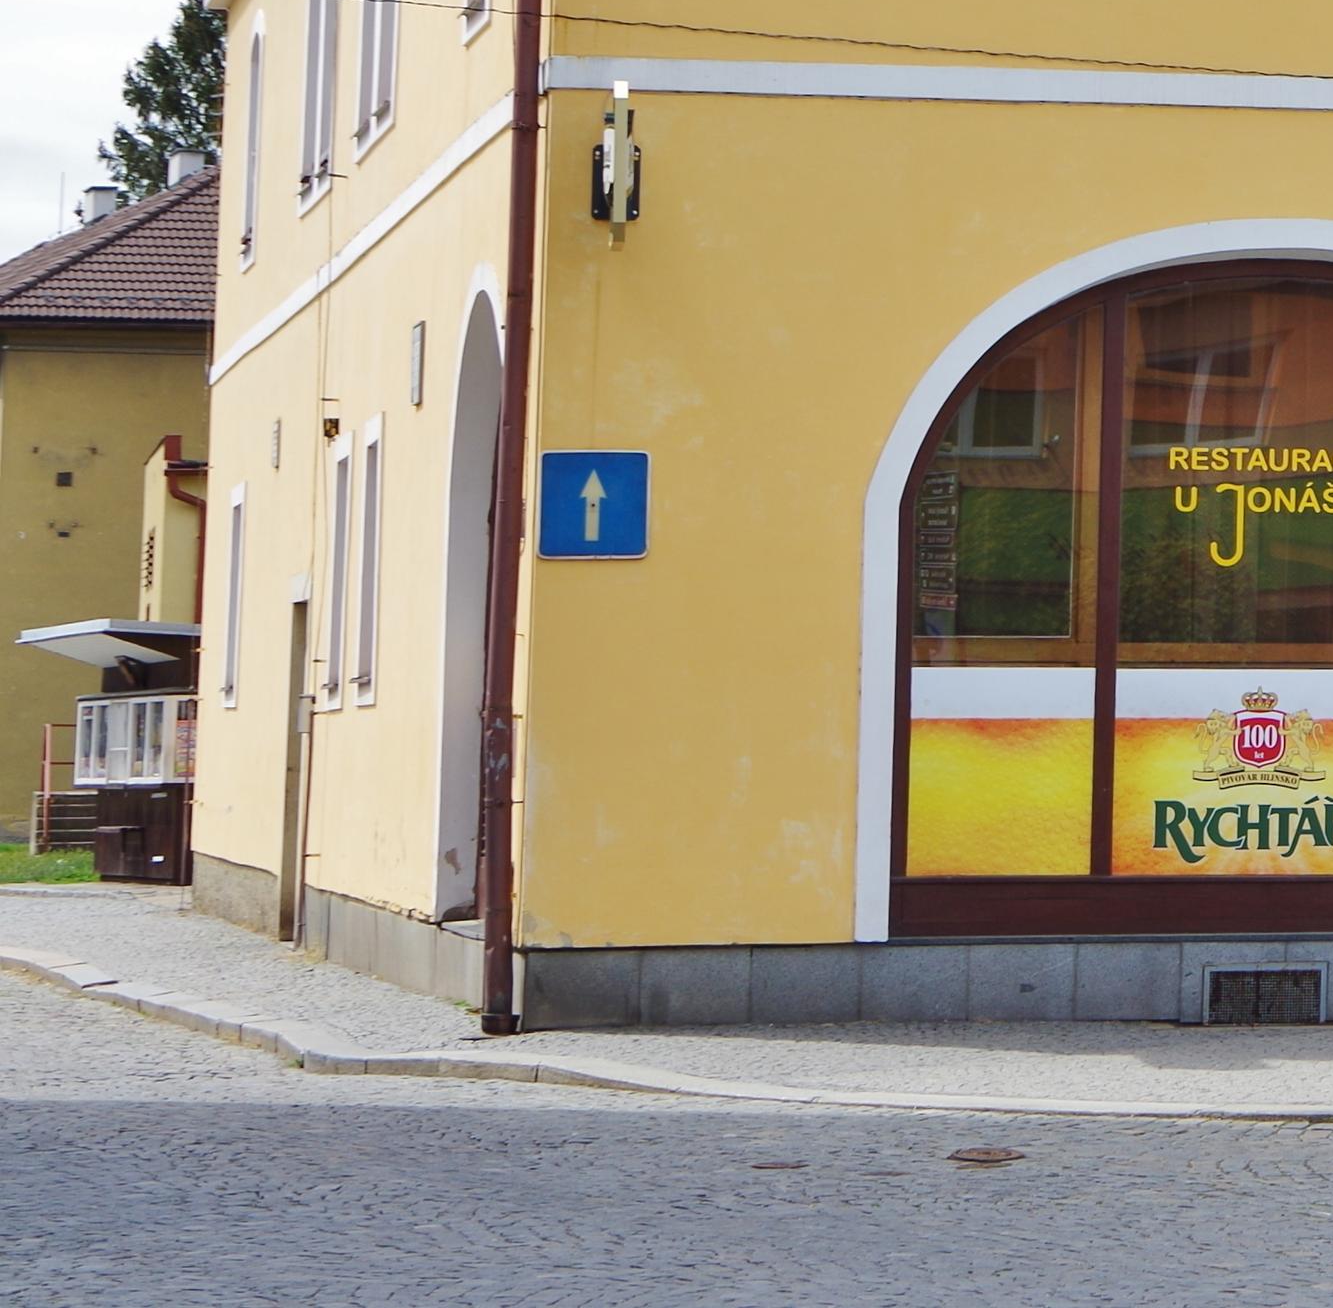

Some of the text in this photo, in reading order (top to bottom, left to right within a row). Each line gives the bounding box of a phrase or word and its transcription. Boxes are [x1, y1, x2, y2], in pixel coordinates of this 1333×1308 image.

[1175, 486, 1198, 513] U
[1242, 724, 1278, 748] 100
[1221, 773, 1297, 786] PIVOVAR HLINSKO
